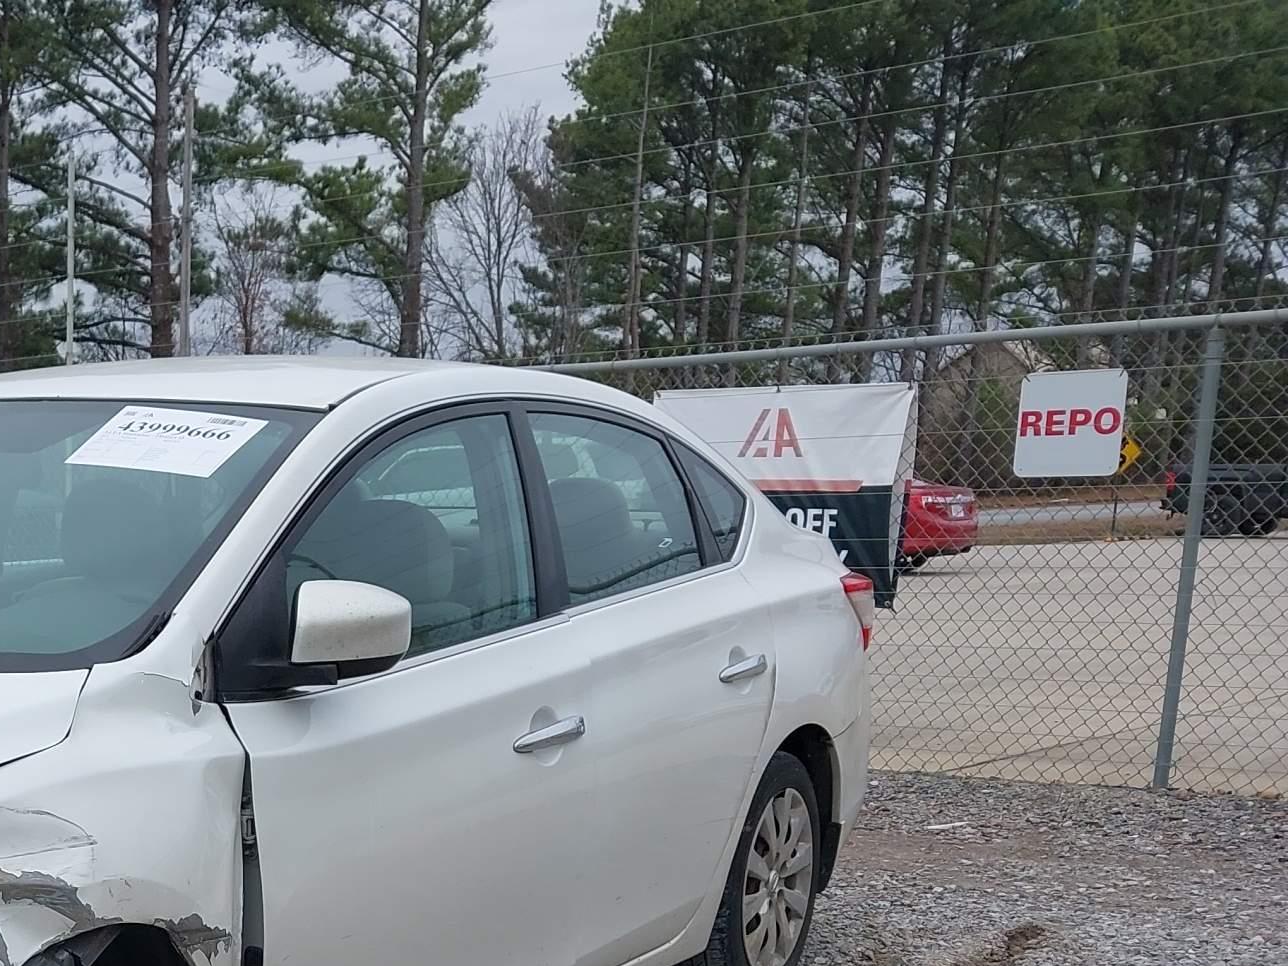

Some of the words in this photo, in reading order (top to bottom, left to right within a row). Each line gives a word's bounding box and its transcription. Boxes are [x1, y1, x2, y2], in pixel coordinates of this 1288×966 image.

[117, 420, 233, 441] 43999666
[1019, 407, 1121, 437] REPO
[785, 507, 838, 538] OFF
